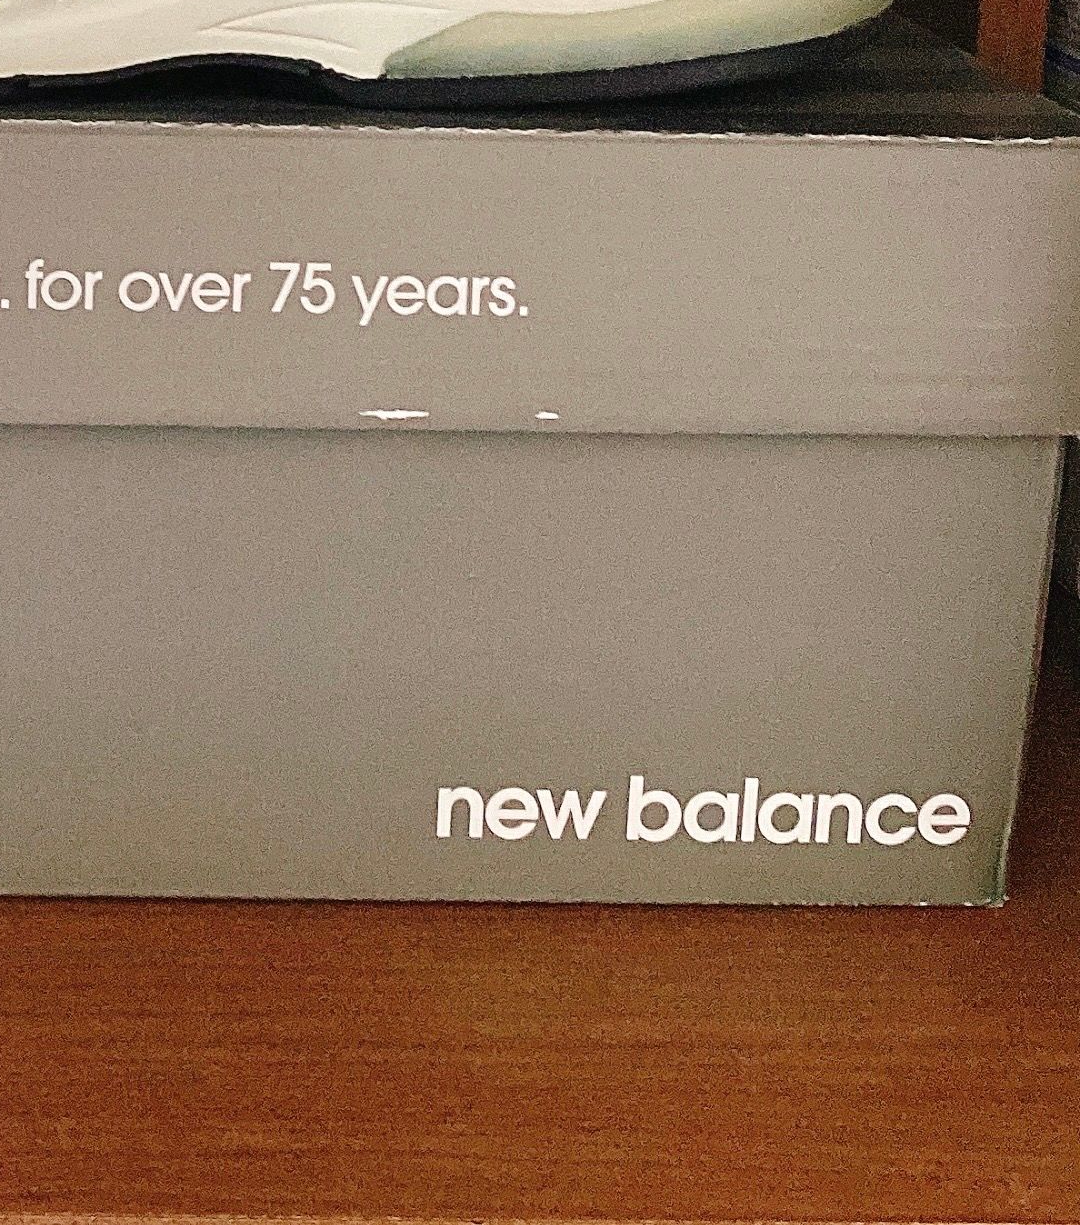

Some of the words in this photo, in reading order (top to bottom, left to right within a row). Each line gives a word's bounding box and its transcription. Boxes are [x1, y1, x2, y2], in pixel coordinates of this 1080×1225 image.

[25, 259, 103, 311] for
[119, 272, 251, 313] over
[270, 262, 335, 314] 75
[352, 276, 528, 327] years.
[436, 786, 607, 840] new
[626, 775, 971, 846] balance
